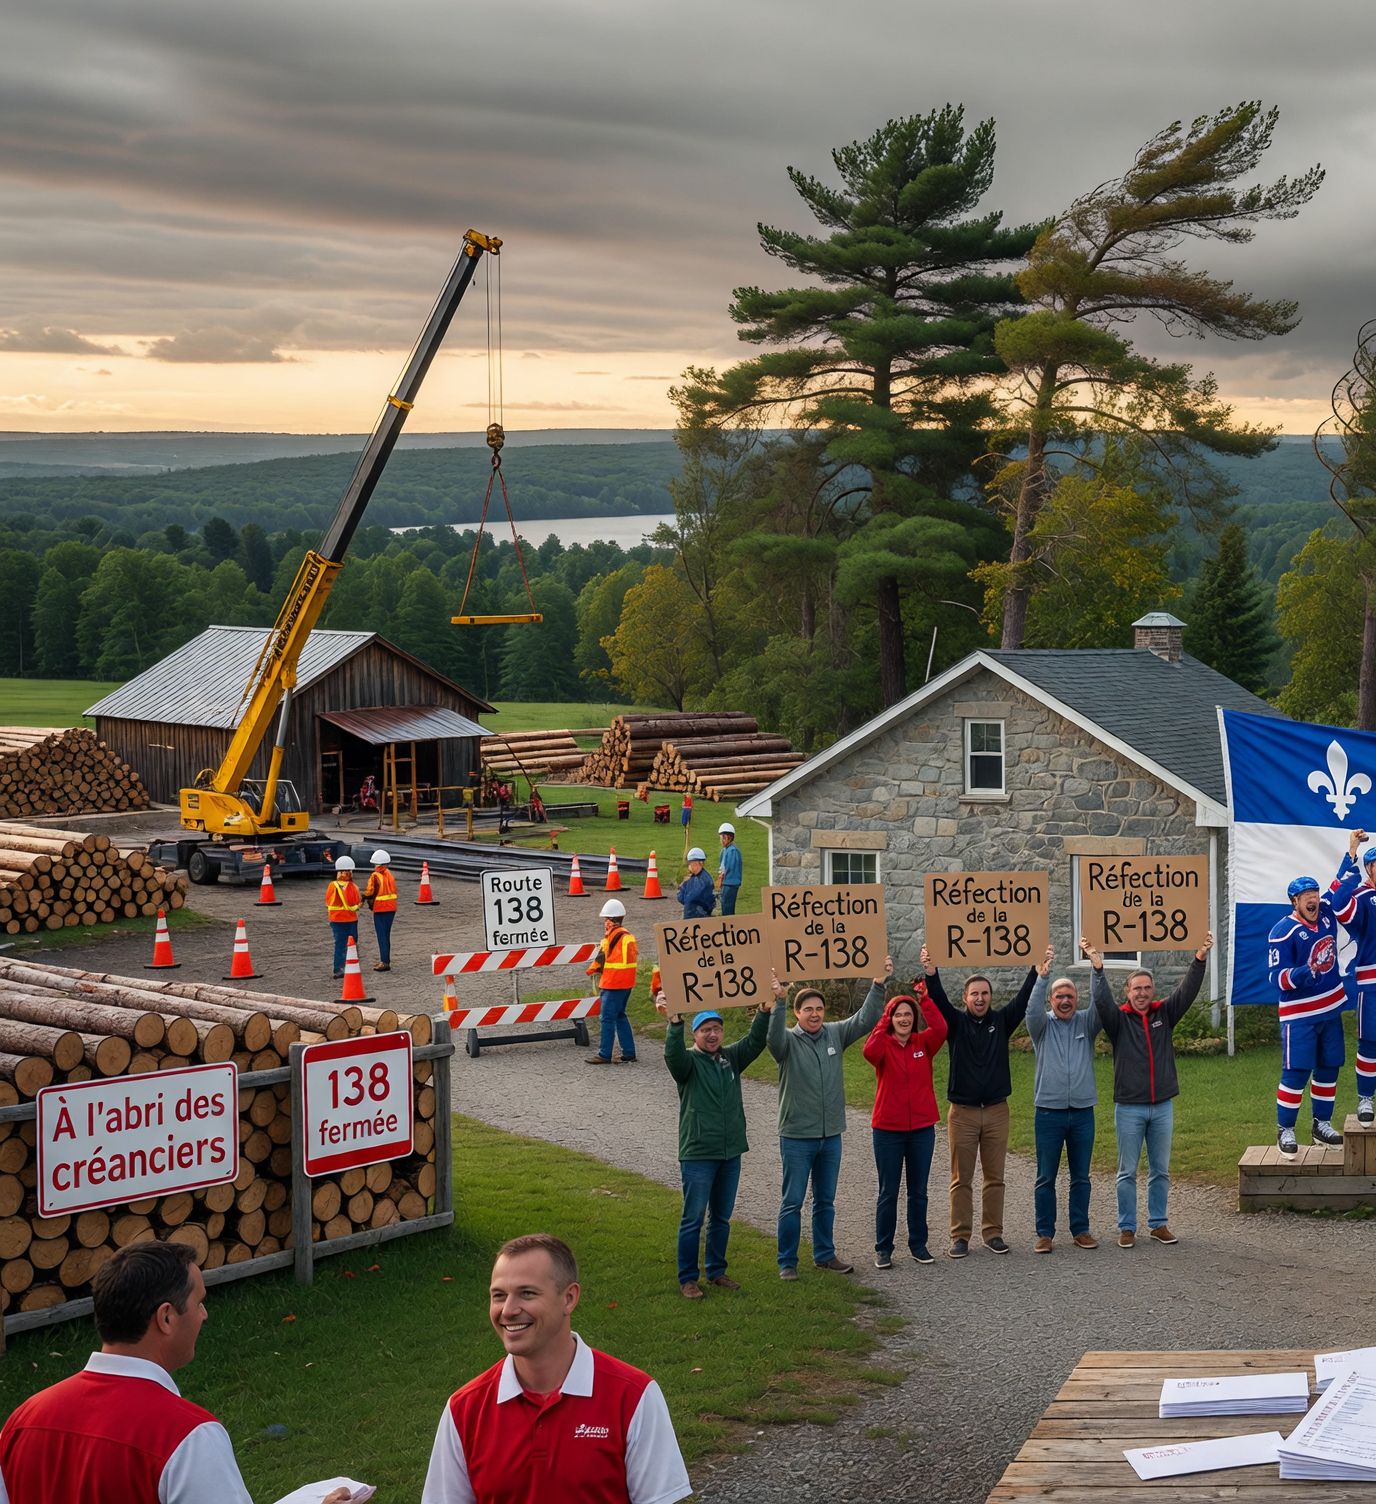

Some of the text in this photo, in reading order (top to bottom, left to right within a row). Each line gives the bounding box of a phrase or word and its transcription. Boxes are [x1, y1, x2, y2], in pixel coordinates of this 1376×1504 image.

[491, 876, 543, 893] Route
[1089, 861, 1199, 891] Réfection
[771, 891, 878, 920] Réfection
[932, 877, 1041, 907] Réfection
[1123, 890, 1164, 907] de la
[493, 896, 544, 926] 138
[966, 906, 1007, 923] de la
[493, 928, 549, 946] fermée
[663, 922, 761, 955] Réfection
[804, 918, 846, 935] de la
[947, 924, 1031, 958] R-138
[1103, 909, 1188, 945] R-138
[697, 949, 735, 968] de la
[784, 935, 870, 973] R-138
[682, 966, 757, 1003] R-138
[328, 1062, 391, 1109] 138
[52, 1087, 226, 1142] À l'abri des
[319, 1108, 398, 1145] fermée
[52, 1134, 226, 1192] créanciers
